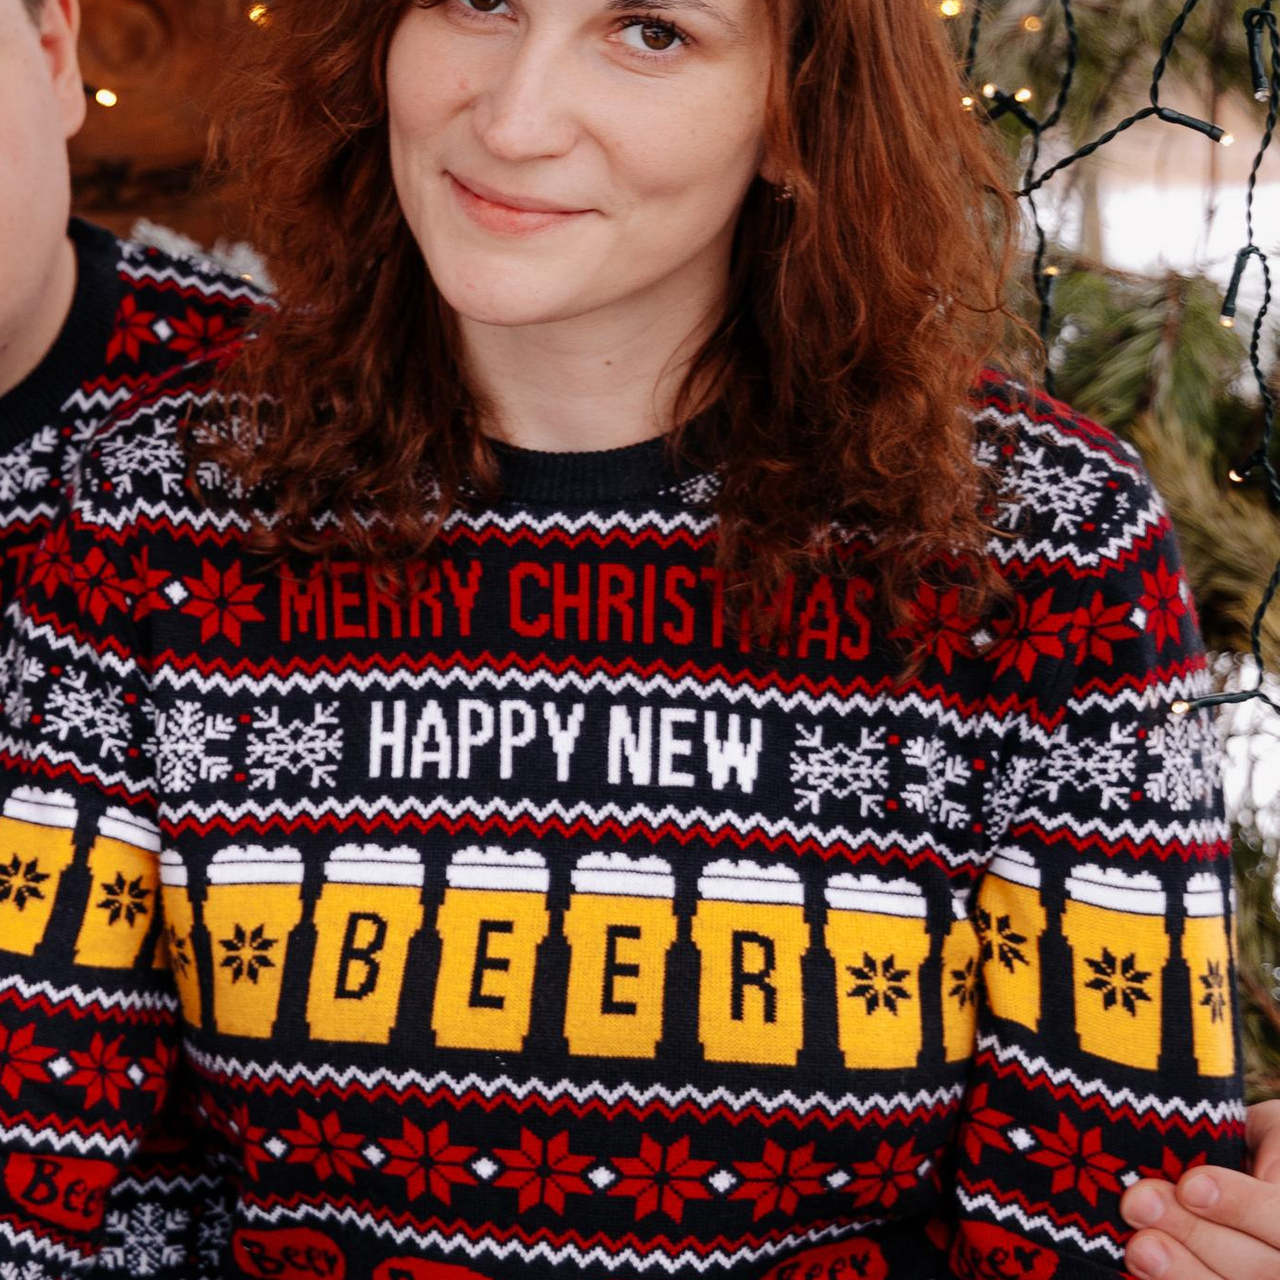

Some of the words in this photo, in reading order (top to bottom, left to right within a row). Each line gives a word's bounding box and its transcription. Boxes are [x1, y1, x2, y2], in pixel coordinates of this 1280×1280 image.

[279, 559, 484, 643] MERRY
[368, 699, 585, 782] HAPPY
[607, 704, 762, 793] NEW
[333, 911, 778, 1024] BEER
[22, 1157, 104, 1218] Bee
[240, 1236, 338, 1278] Beer
